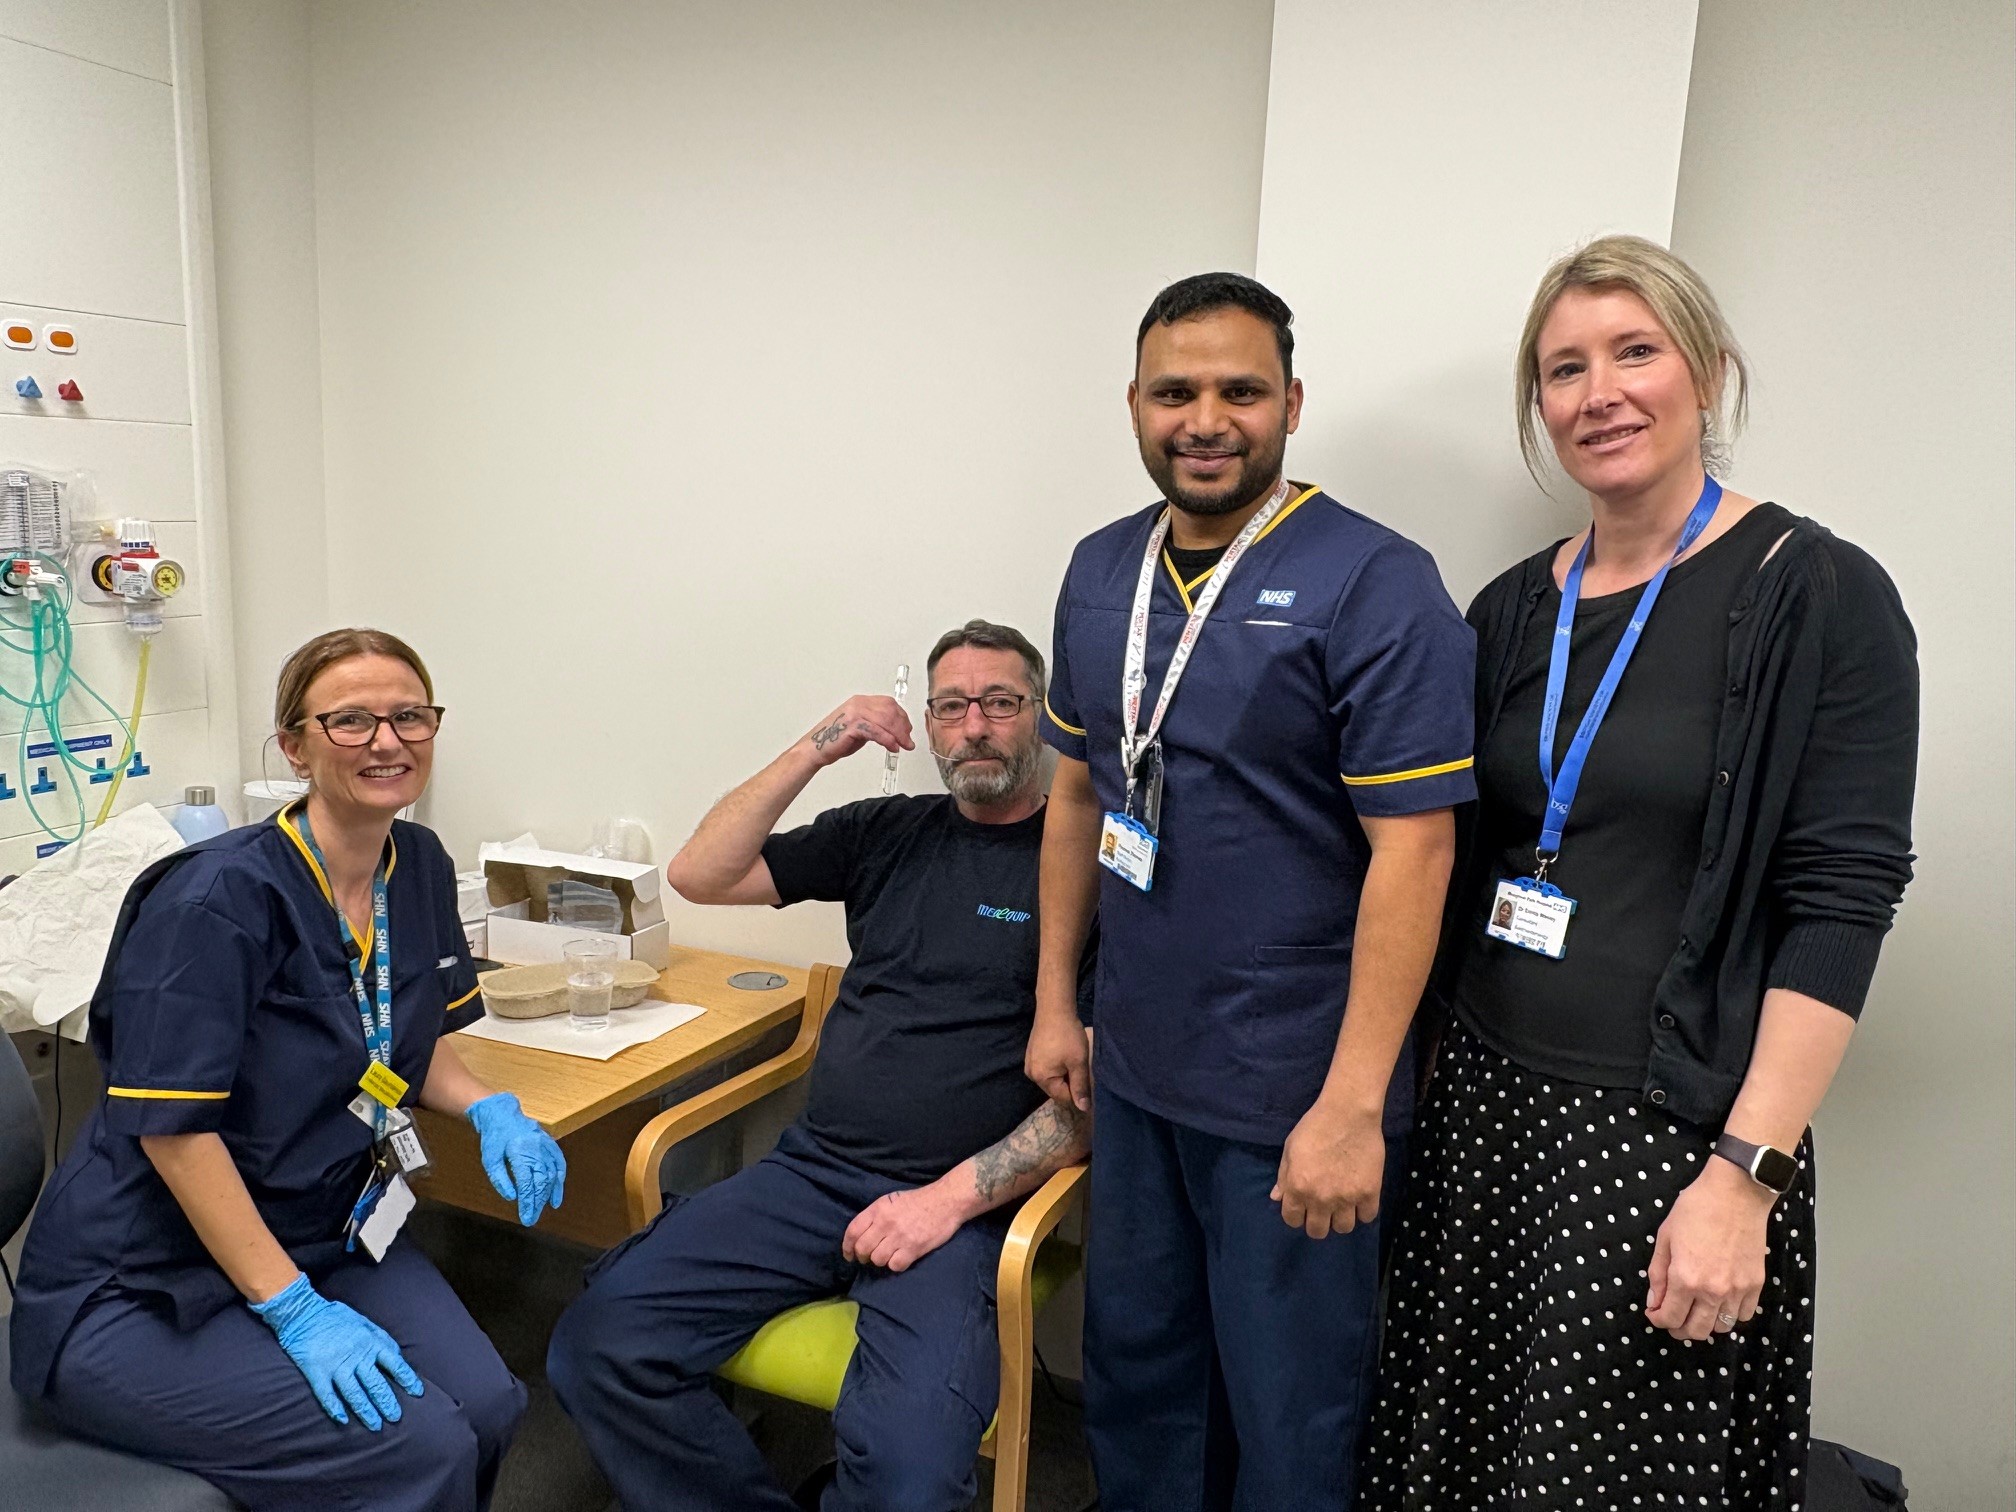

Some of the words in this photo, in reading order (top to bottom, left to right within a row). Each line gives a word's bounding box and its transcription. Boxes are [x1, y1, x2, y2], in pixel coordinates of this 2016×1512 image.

[1259, 590, 1294, 605] NHS
[374, 892, 386, 917] NHS
[376, 928, 388, 954] NHS
[377, 965, 390, 991] NHS
[361, 1012, 375, 1038] NHS
[379, 1002, 391, 1028] NHS
